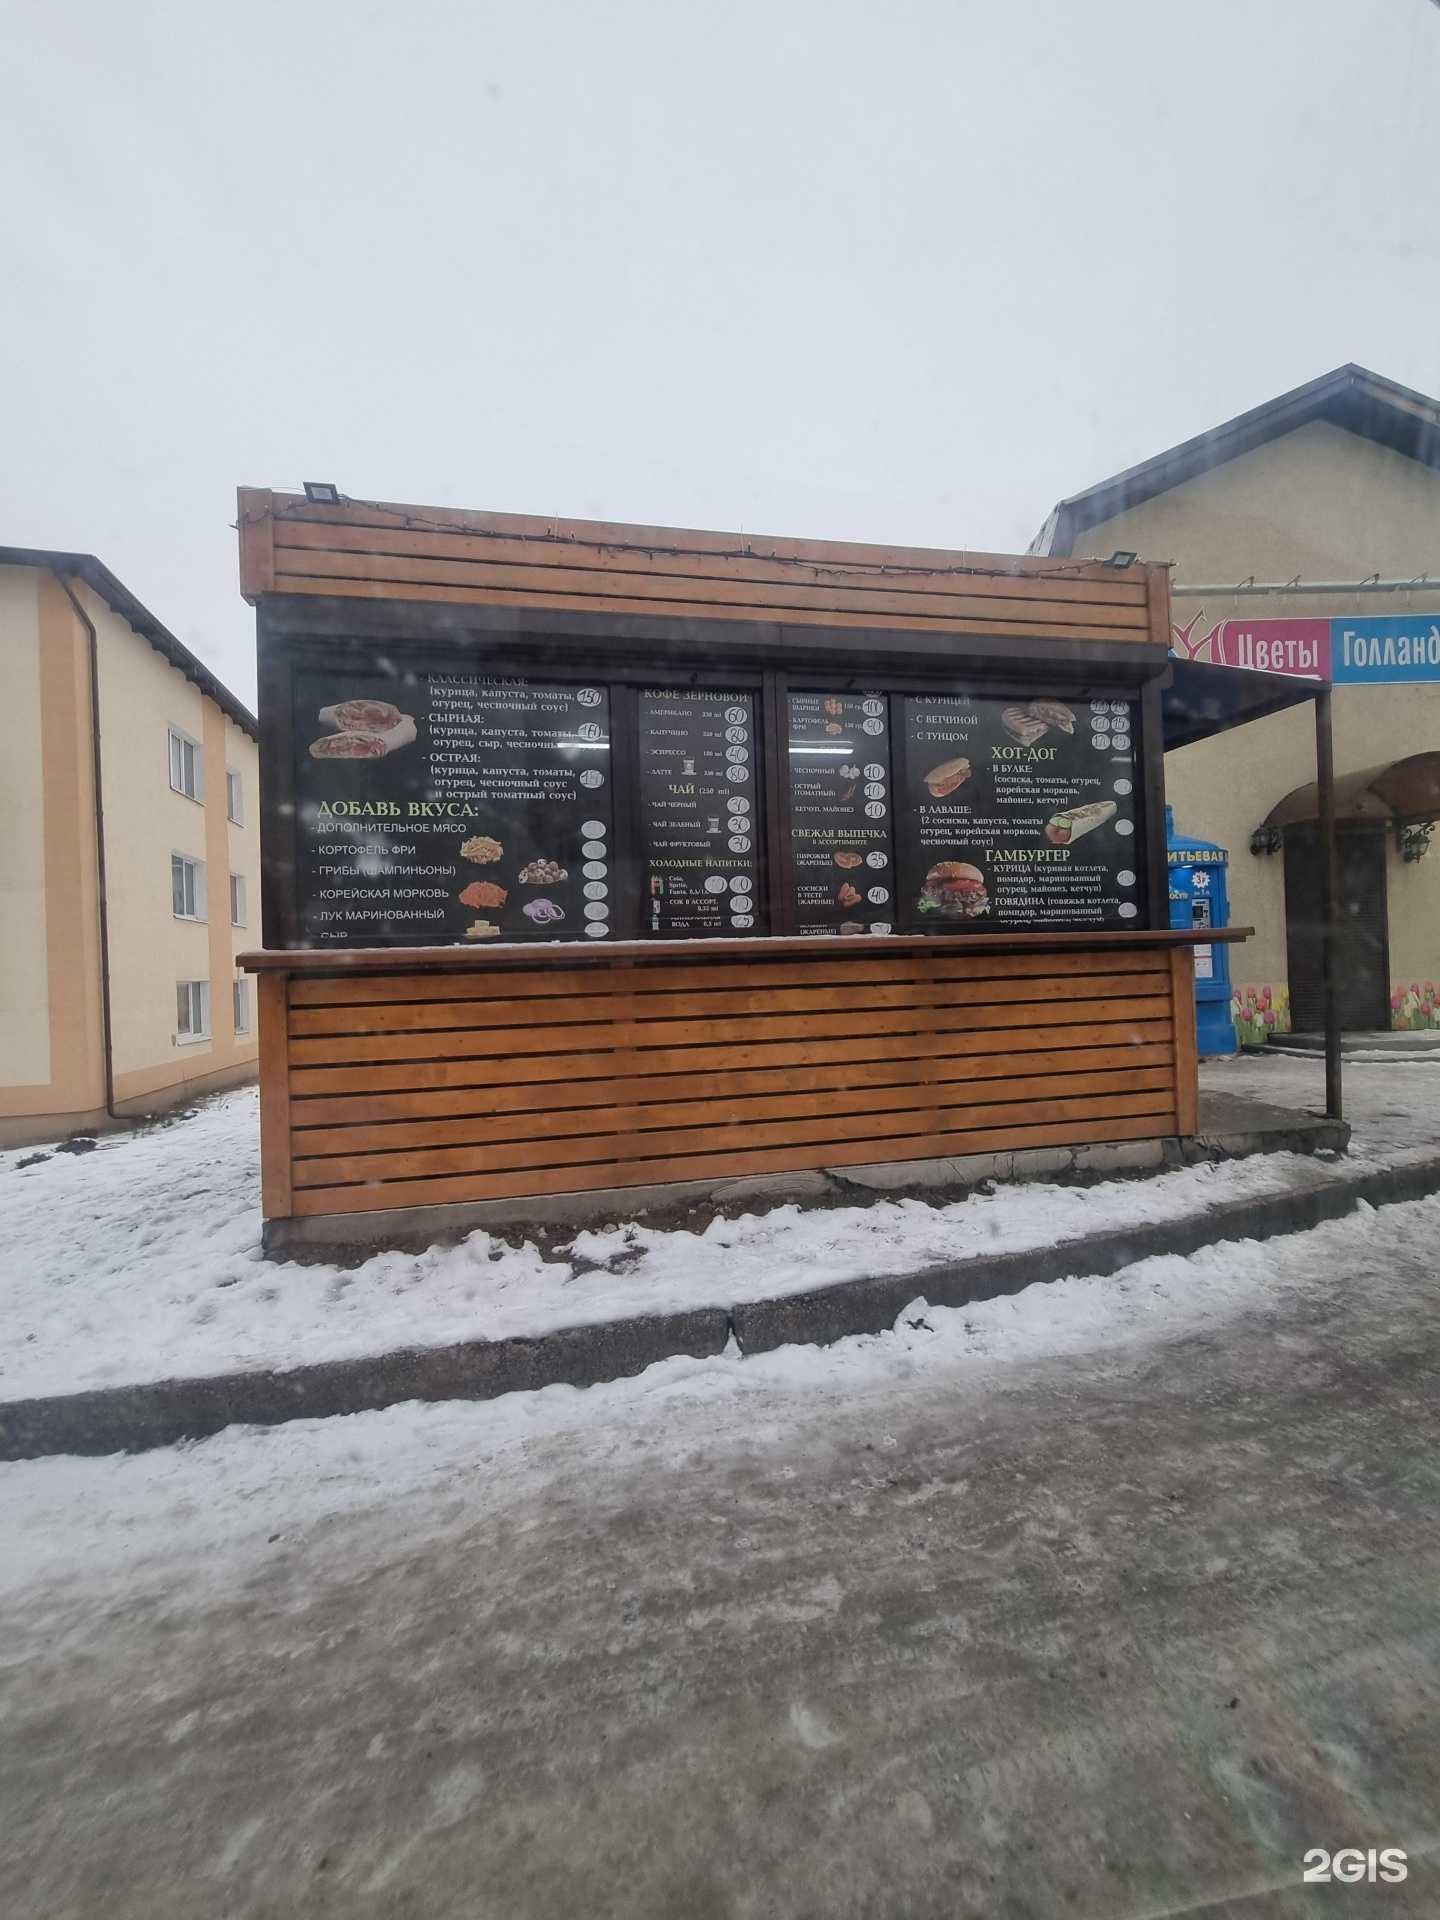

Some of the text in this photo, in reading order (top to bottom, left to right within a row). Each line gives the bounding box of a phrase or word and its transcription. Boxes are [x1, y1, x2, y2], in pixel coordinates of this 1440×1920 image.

[1238, 625, 1440, 670] Цветы Голланд
[430, 688, 574, 700] (курица, капуста, томаты,
[644, 689, 679, 699] КОФЕ
[432, 700, 568, 713] огурец, чесночный соус)
[429, 713, 484, 723] СЫРНАЯ:
[728, 708, 744, 723] 60
[926, 715, 978, 725] ВЕТЧИНОЙ
[430, 725, 477, 736] (курица,
[481, 728, 527, 737] капуста,
[927, 733, 968, 741] ТУНЦОМ
[434, 739, 474, 747] огурец,
[479, 740, 502, 749] сыр,
[430, 754, 480, 762] ОСТРАЯ:
[992, 747, 1056, 762] ХОТ-ДОГ
[431, 765, 575, 777] (курица, капуста, томаты,
[1001, 765, 1032, 773] БУЛКЕ:
[435, 778, 567, 789] огурец, чесночный соус
[1036, 777, 1069, 785] томаты,
[1071, 777, 1100, 786] огурец,
[669, 783, 694, 794] ЧАЙ
[996, 786, 1040, 795] корейская
[446, 791, 487, 800] острый
[492, 791, 545, 800] томатный
[549, 792, 577, 800] соус)
[317, 801, 478, 818] ДОБАВЬ ВКУСА:
[929, 806, 972, 814] ЛАВАШЕ:
[973, 818, 1009, 826] капуста,
[317, 823, 466, 833] ДОПОЛНИТЕЛЬНОЕ МЯСО
[920, 828, 952, 837] огурец,
[955, 827, 1001, 836] корейская
[792, 830, 887, 838] СВЕЖАЯ ВЫПЕЧКА
[920, 837, 993, 846] чесночный соус)
[319, 845, 415, 854] КОРТОФЕЛЬ ФРИ
[985, 850, 1071, 862] ГАМБУРГЕР
[650, 860, 702, 868] ХОЛОДНЫЕ
[994, 865, 1031, 873] КУРИЦА
[320, 866, 360, 875] ГРИБЫ
[320, 888, 449, 899] КОРЕЙСКАЯ МОРКОВЬ
[997, 885, 1028, 894] огурец,
[995, 897, 1045, 906] ГОВЯДИНА
[320, 908, 444, 921] ЛУК МАРИНОВАННЫЙ
